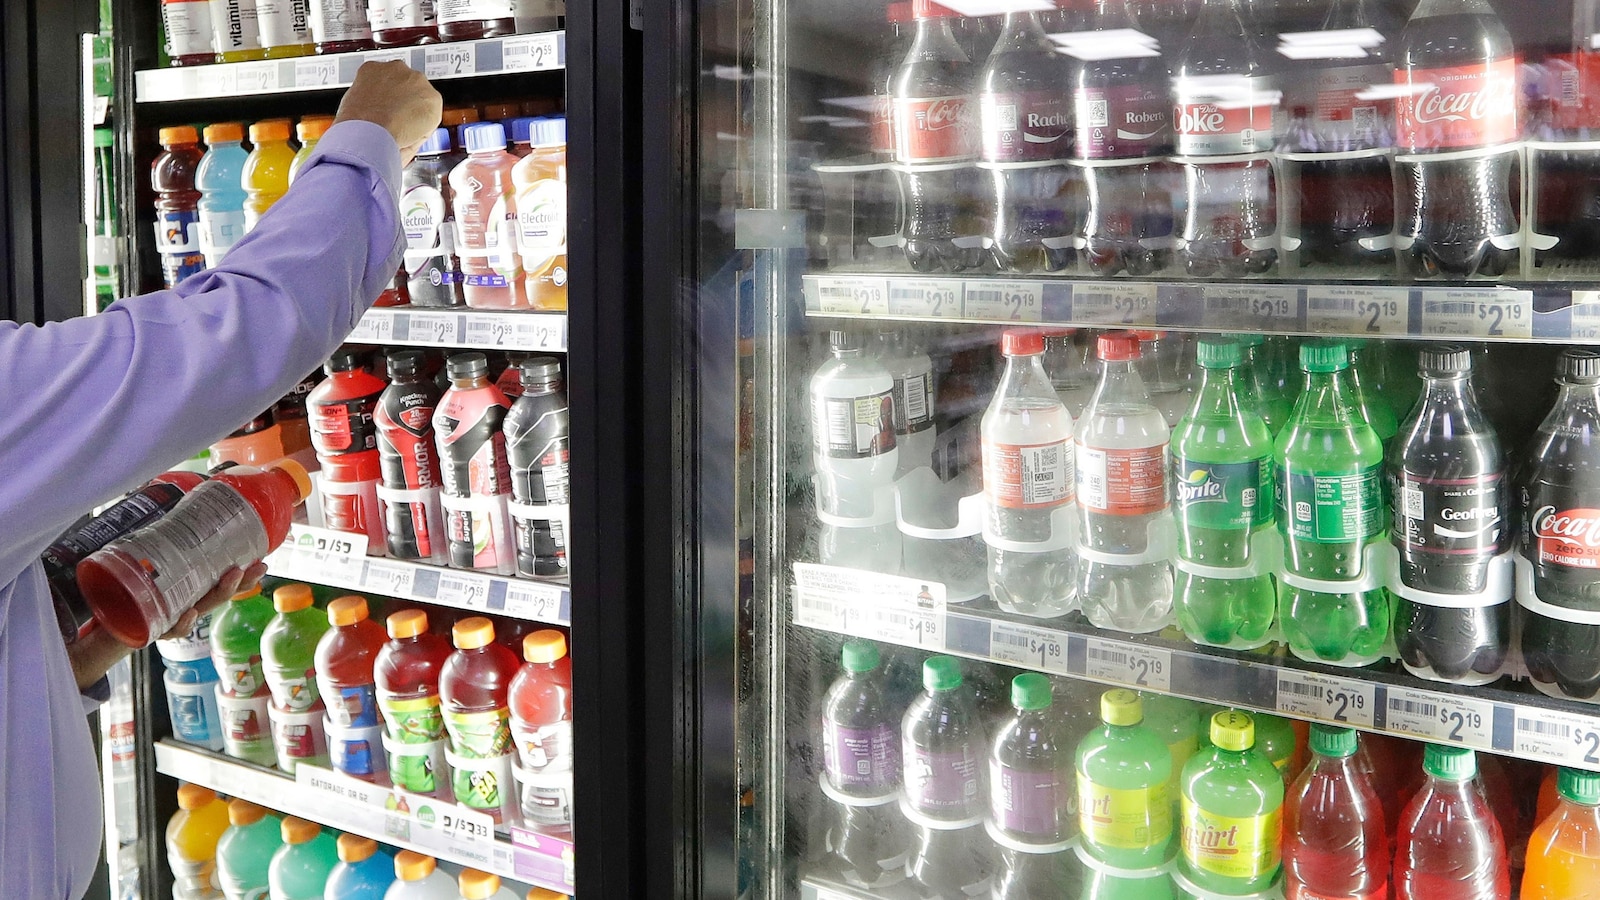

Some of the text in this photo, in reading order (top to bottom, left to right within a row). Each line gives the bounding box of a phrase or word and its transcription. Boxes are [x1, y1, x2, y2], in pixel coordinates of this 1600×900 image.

[1440, 74, 1478, 82] ORIGINAL
[403, 214, 433, 227] lectrolit
[854, 288, 880, 314] $219
[926, 290, 954, 317] $219
[1004, 292, 1035, 320] $219
[1115, 295, 1148, 324] $219
[1358, 300, 1398, 332] $219
[1479, 302, 1522, 336] $219
[492, 324, 513, 346] $299
[1176, 478, 1221, 503] Sprite
[1297, 504, 1310, 513] 240
[1555, 544, 1584, 555] zero
[464, 586, 484, 606] $259
[909, 618, 937, 645] $199
[1030, 638, 1061, 668] $199
[1129, 655, 1162, 686] $219
[1326, 688, 1364, 722] $219
[1405, 691, 1420, 699] Coke
[1421, 694, 1440, 703] Cherry
[1440, 707, 1482, 742] $219
